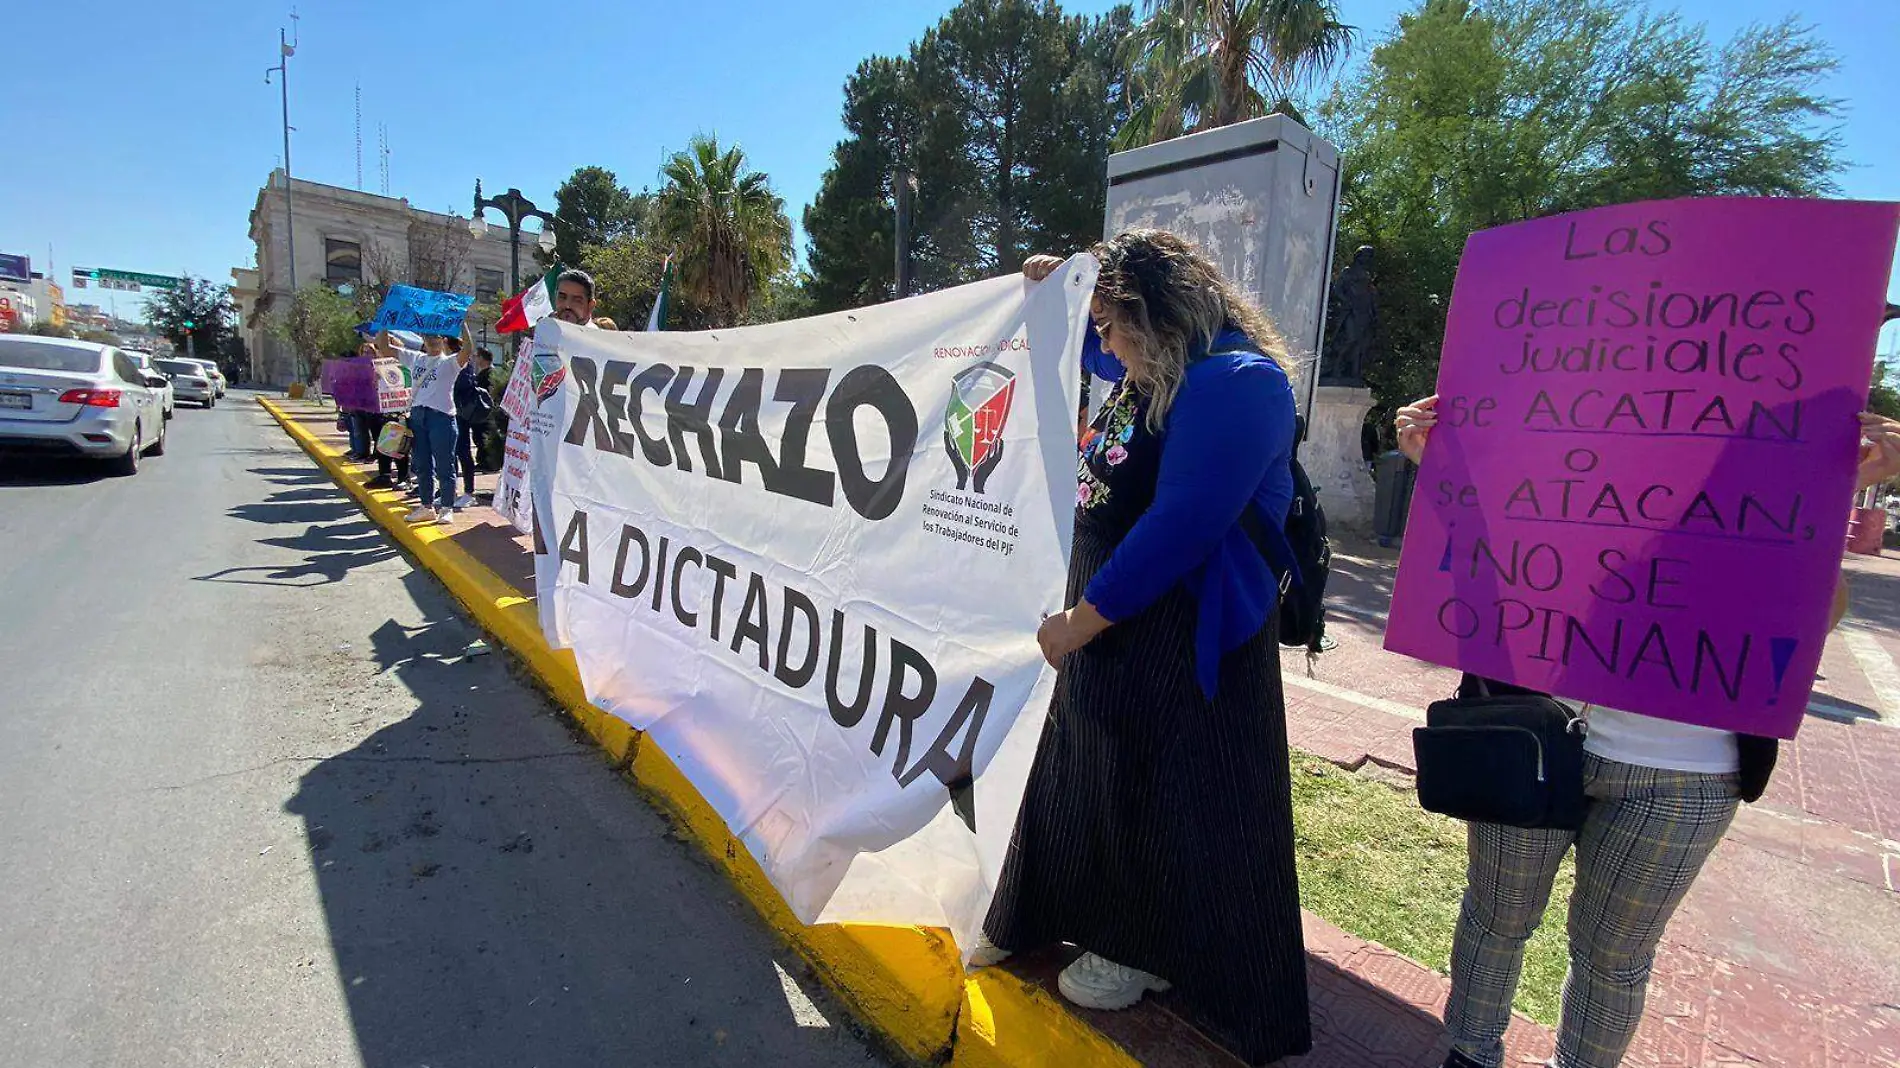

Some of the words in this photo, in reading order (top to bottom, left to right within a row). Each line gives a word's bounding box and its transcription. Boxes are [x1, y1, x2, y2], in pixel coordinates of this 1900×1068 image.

[1564, 218, 1671, 261] Las
[1494, 281, 1816, 335] decisiones
[1500, 332, 1803, 391] judiciales
[564, 355, 918, 521] RECHAZO
[1447, 394, 1497, 429] se
[1523, 389, 1802, 440] ACATAN
[922, 503, 964, 522] Renovación
[965, 514, 974, 525] al
[974, 516, 1007, 534] Servicio
[1008, 524, 1019, 537] de
[929, 489, 964, 505] Sindicato
[964, 496, 1002, 514] Nacional
[1003, 504, 1013, 517] de
[1437, 482, 1479, 507] se
[1505, 478, 1817, 542] ATACAN,
[923, 520, 934, 532] los
[935, 523, 984, 547] Trabajadores
[986, 537, 1000, 551] del
[1000, 541, 1014, 556] PJF
[1588, 548, 1692, 609] SE
[610, 523, 996, 835] DICTADURA
